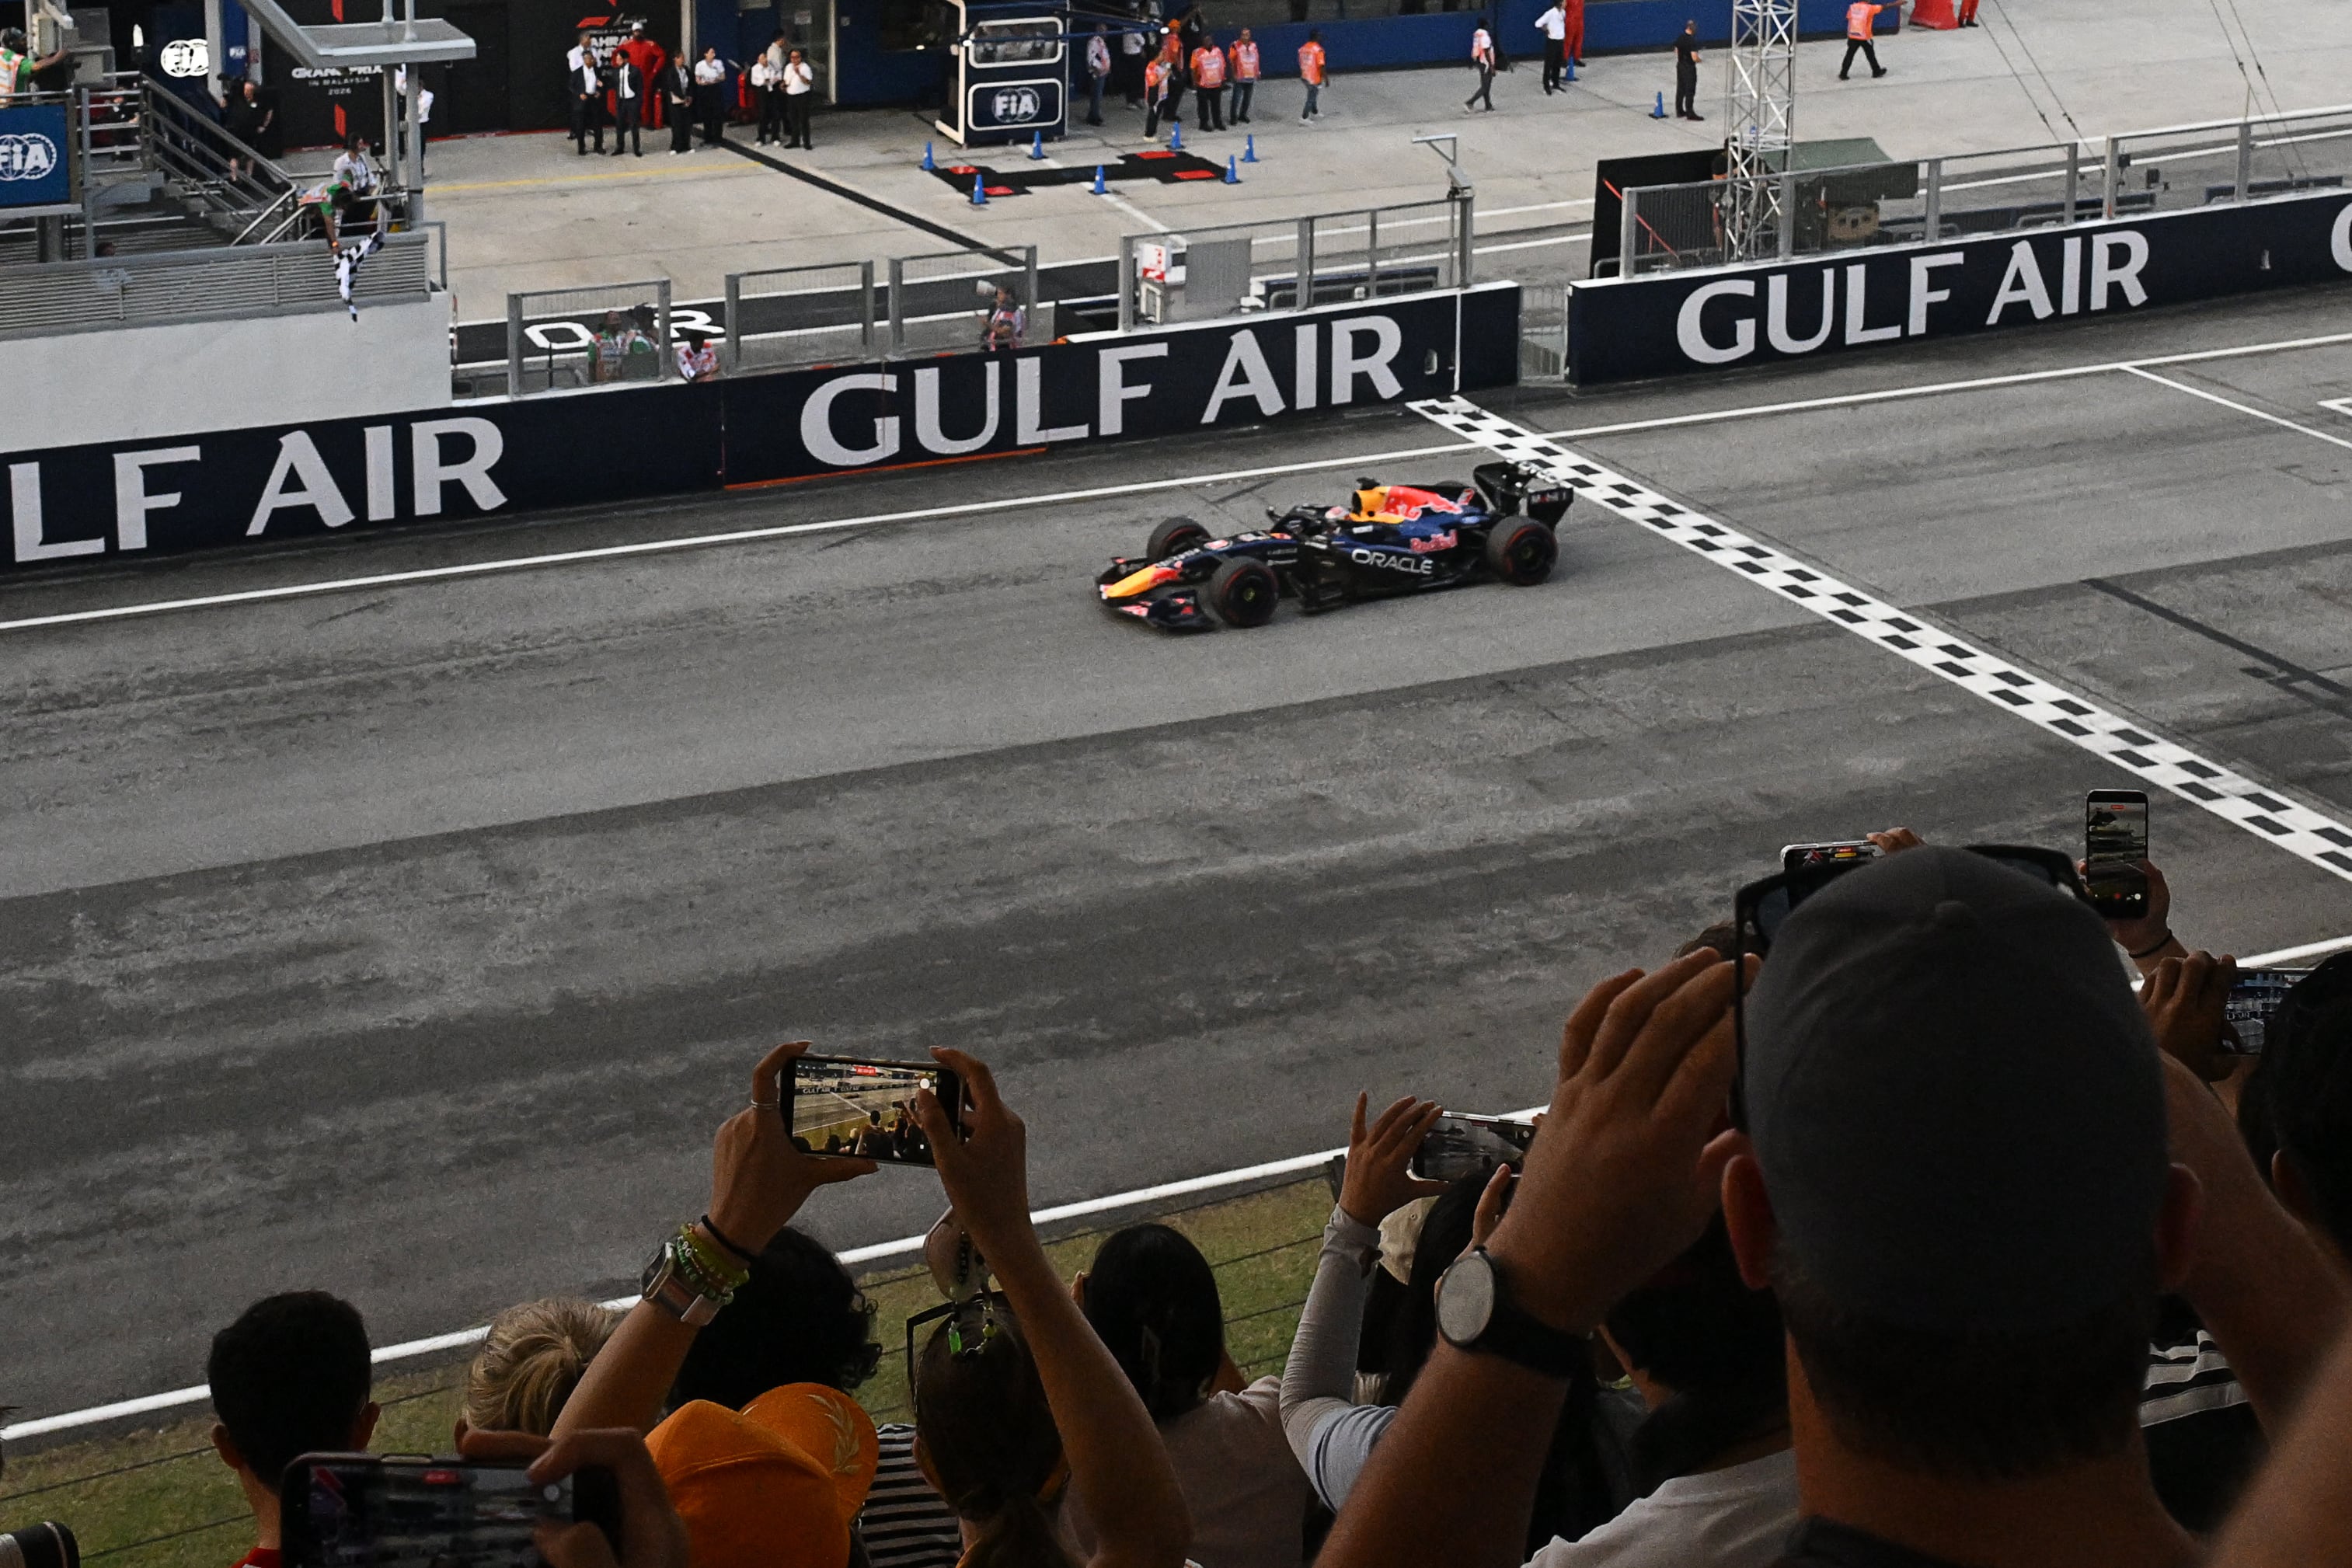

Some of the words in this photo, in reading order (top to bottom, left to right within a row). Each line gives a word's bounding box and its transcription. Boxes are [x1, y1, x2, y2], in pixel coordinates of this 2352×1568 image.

[322, 76, 370, 86] MALAYSIA
[1677, 251, 1964, 364] GULF
[1986, 230, 2150, 325] AIR
[800, 342, 1169, 465] GULF
[1200, 315, 1404, 423] AIR
[9, 445, 201, 563] LF
[246, 416, 508, 536] AIR
[1352, 549, 1434, 574] ORACLE
